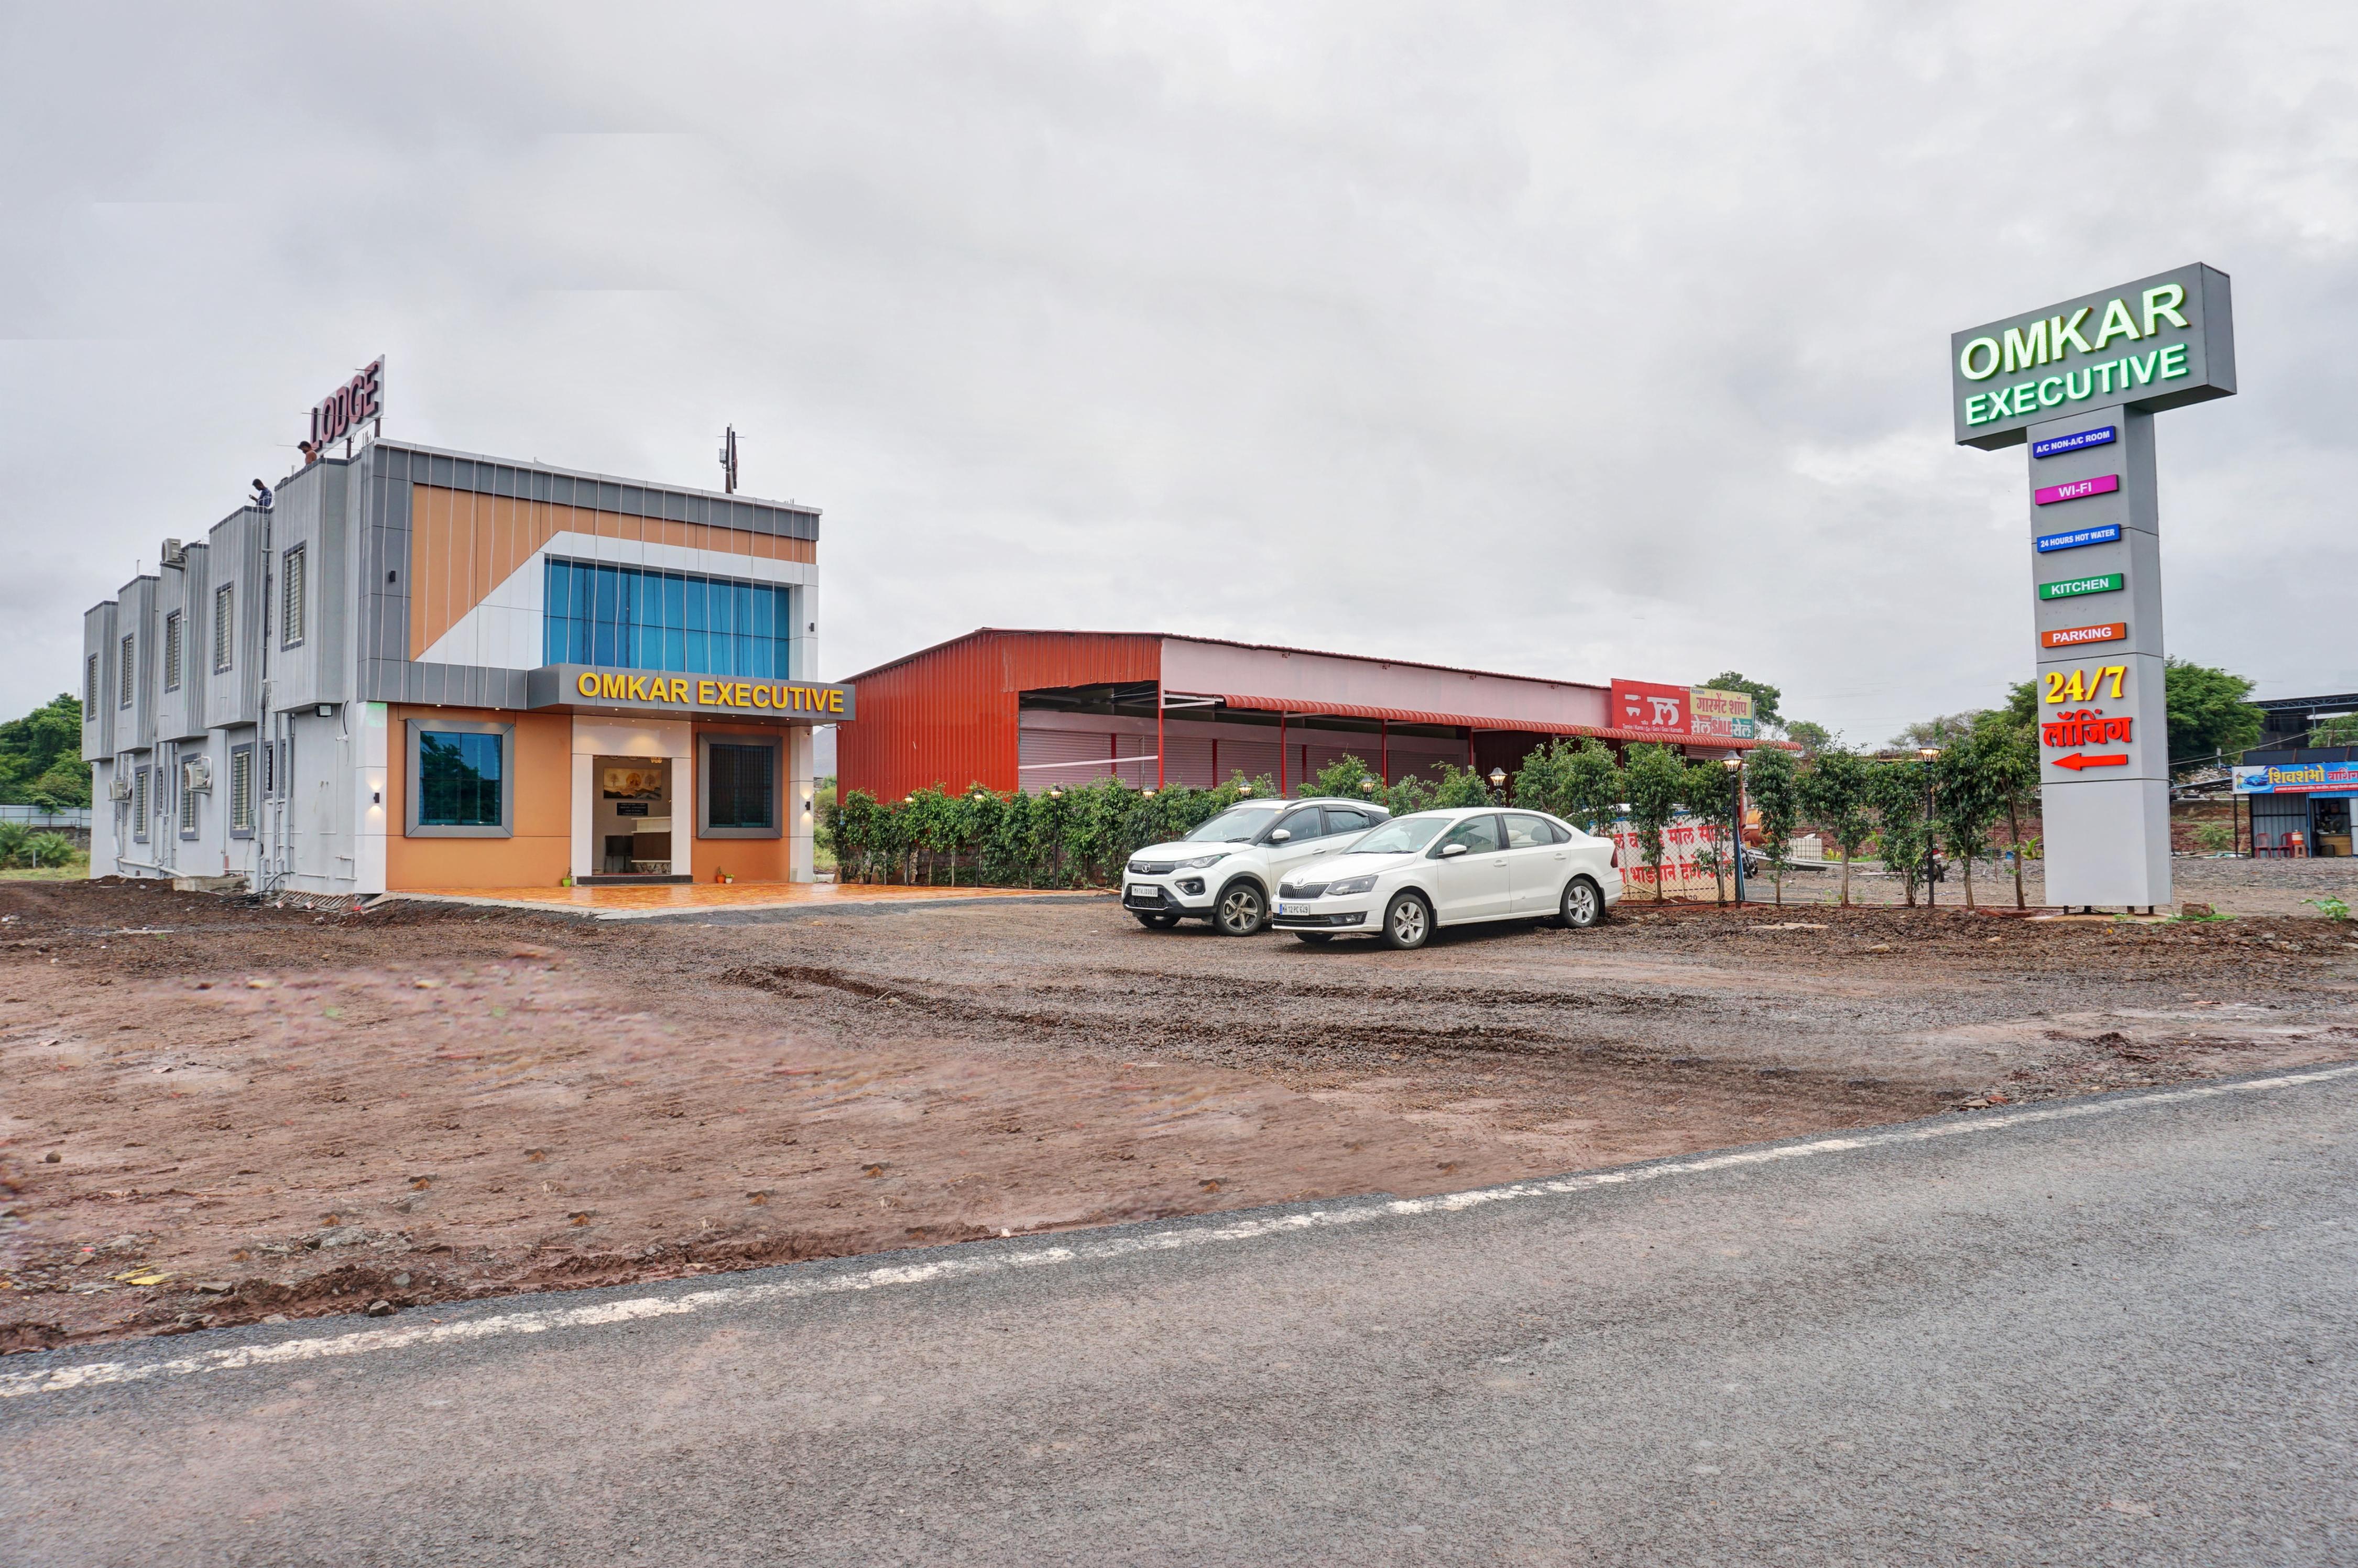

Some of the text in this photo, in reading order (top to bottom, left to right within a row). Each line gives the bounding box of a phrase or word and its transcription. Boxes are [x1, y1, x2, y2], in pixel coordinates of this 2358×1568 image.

[1960, 283, 2191, 381] OMKAR
[1965, 343, 2189, 426] EXECUTIVE
[310, 360, 381, 453] LODGE
[2036, 431, 2110, 453] A/C NON-A/C ROOM
[2058, 482, 2092, 497] WI-FI
[2050, 535, 2073, 546] HOURS
[2075, 533, 2090, 542] HOT
[2090, 529, 2115, 540] WATER
[2051, 577, 2109, 595] KITCHEN
[2053, 627, 2112, 643] PARKING
[577, 672, 845, 713] OMKAR EXECUTIVE
[2045, 665, 2128, 704] 24/7
[1712, 719, 1732, 735] SALE
[1732, 718, 1751, 737] सेल
[2042, 709, 2133, 747] लॉजिंग
[2268, 764, 2326, 784] शिवशंभो
